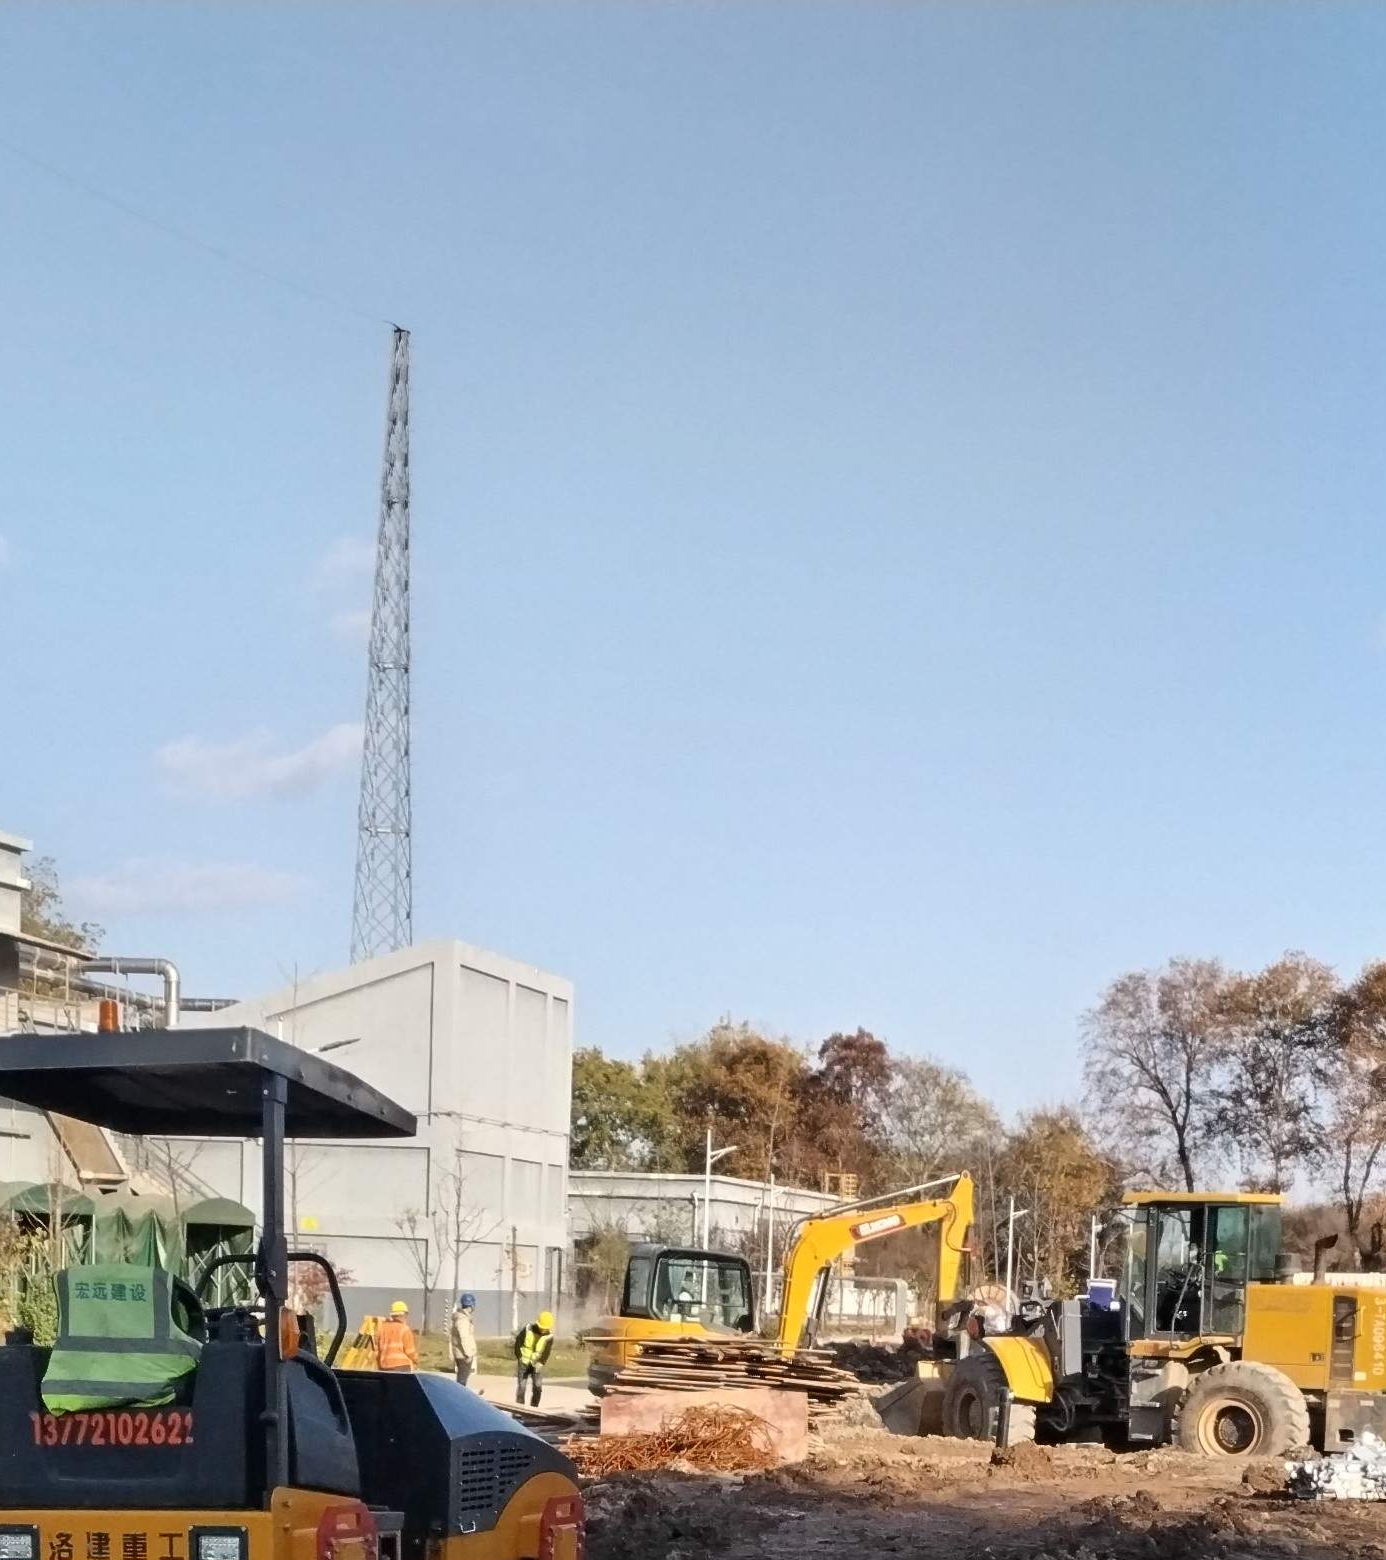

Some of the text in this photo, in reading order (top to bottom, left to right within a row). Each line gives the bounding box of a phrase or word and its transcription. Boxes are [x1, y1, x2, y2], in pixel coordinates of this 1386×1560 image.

[75, 1282, 147, 1302] 宏远建设
[49, 1531, 185, 1560] 洛建重工
